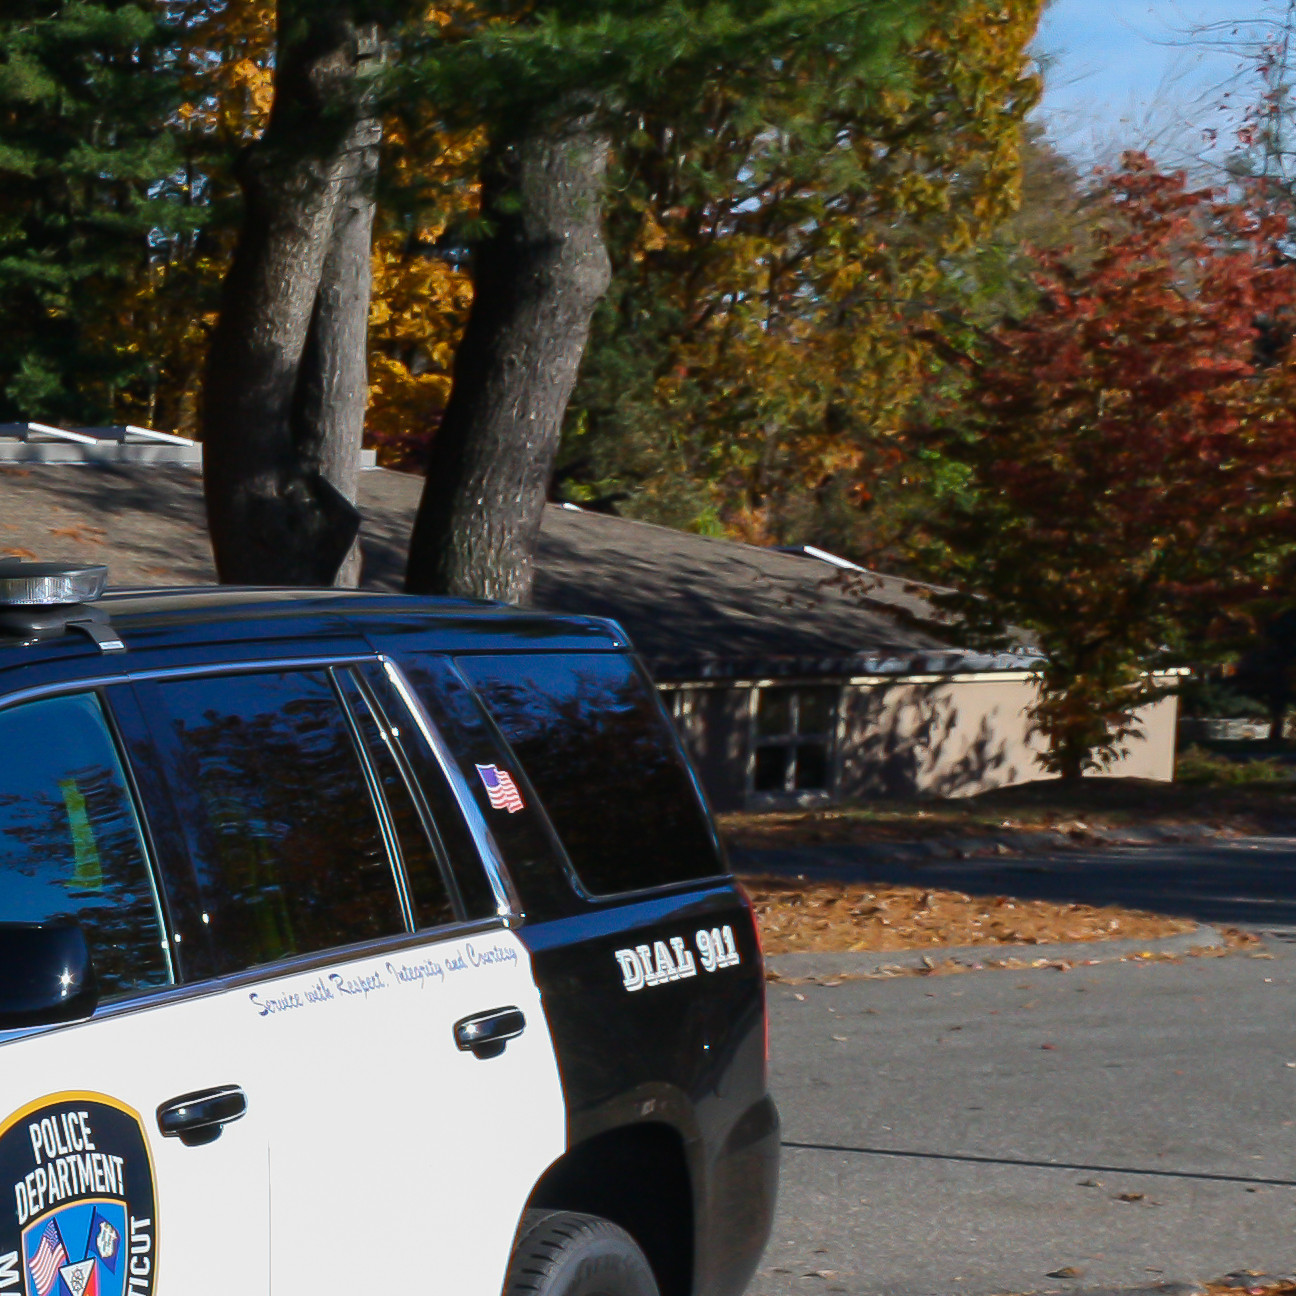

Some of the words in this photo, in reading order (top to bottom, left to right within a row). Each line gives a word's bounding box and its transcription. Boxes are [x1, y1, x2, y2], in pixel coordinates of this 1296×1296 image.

[249, 992, 304, 1016] Service
[304, 977, 334, 1003] with
[385, 961, 445, 989] Integrity
[445, 949, 468, 972] and
[466, 943, 518, 968] Courtesy
[614, 936, 697, 992] DIAL
[695, 925, 740, 973] 911
[28, 1111, 96, 1165] POLICE
[14, 1156, 125, 1226] DEPARTMENT
